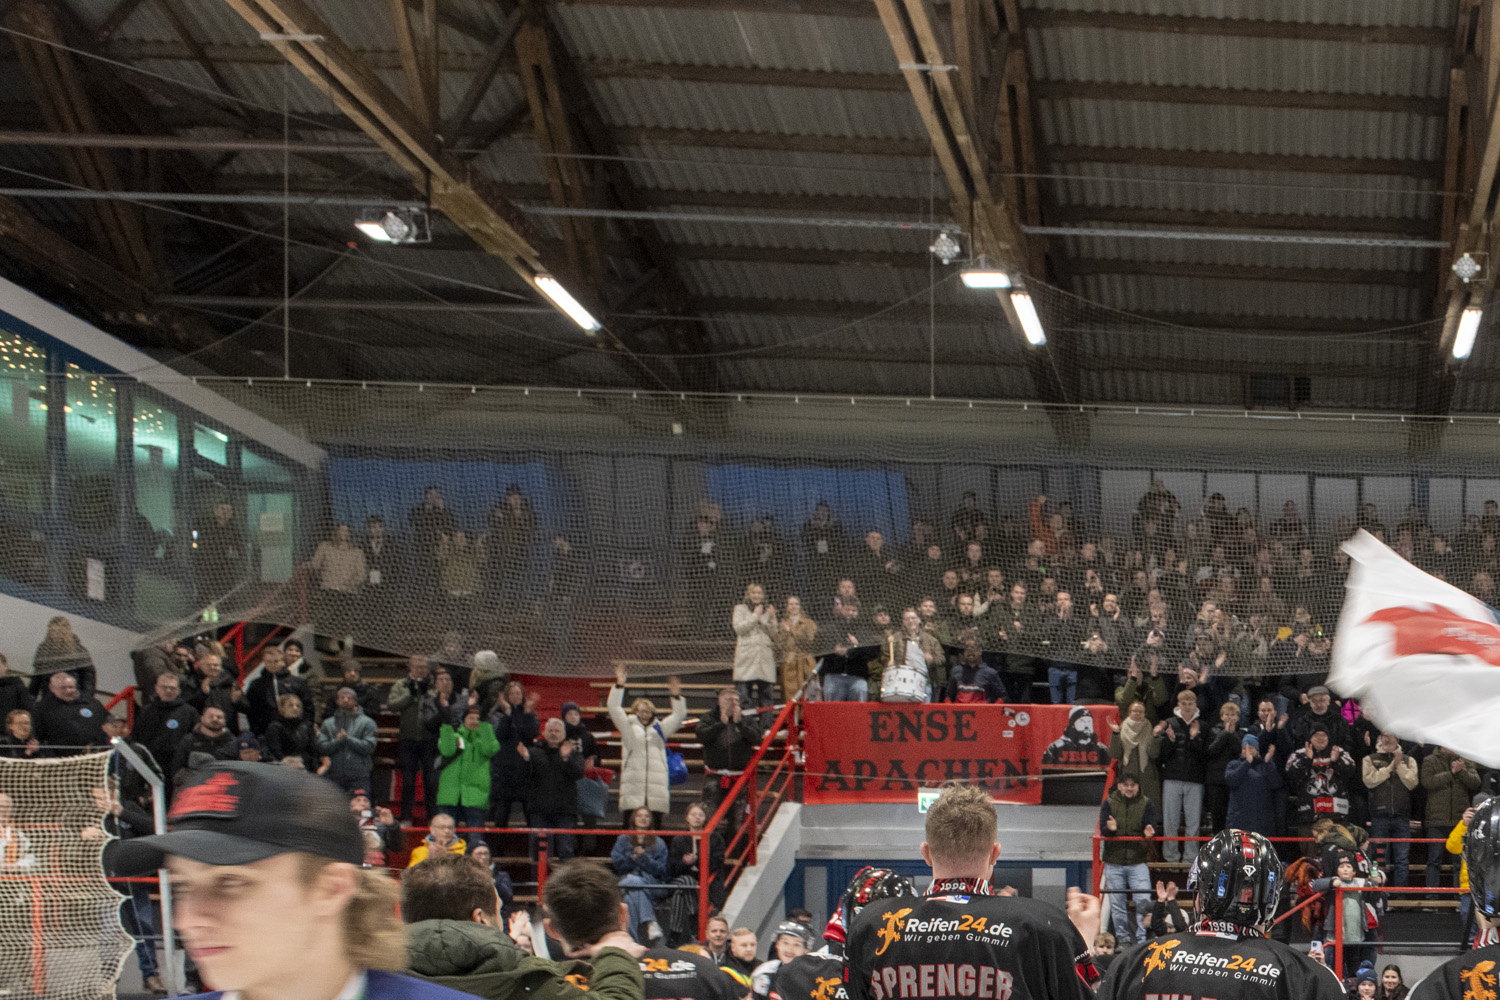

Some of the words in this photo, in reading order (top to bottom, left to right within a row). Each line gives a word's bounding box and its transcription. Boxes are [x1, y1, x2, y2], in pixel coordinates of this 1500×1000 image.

[869, 710, 978, 742] ENSE
[1059, 751, 1098, 762] JB16
[817, 759, 1030, 791] APACHEN
[905, 914, 1013, 938] Reifen24.de
[1207, 921, 1235, 932] 1996
[904, 933, 922, 943] Wir
[926, 933, 960, 943] geben
[966, 932, 1010, 947] Gummi!
[1169, 963, 1187, 972] Wir
[1192, 965, 1229, 978] geben
[1234, 972, 1277, 987] Gummi!
[1172, 949, 1281, 978] Reifen24.de
